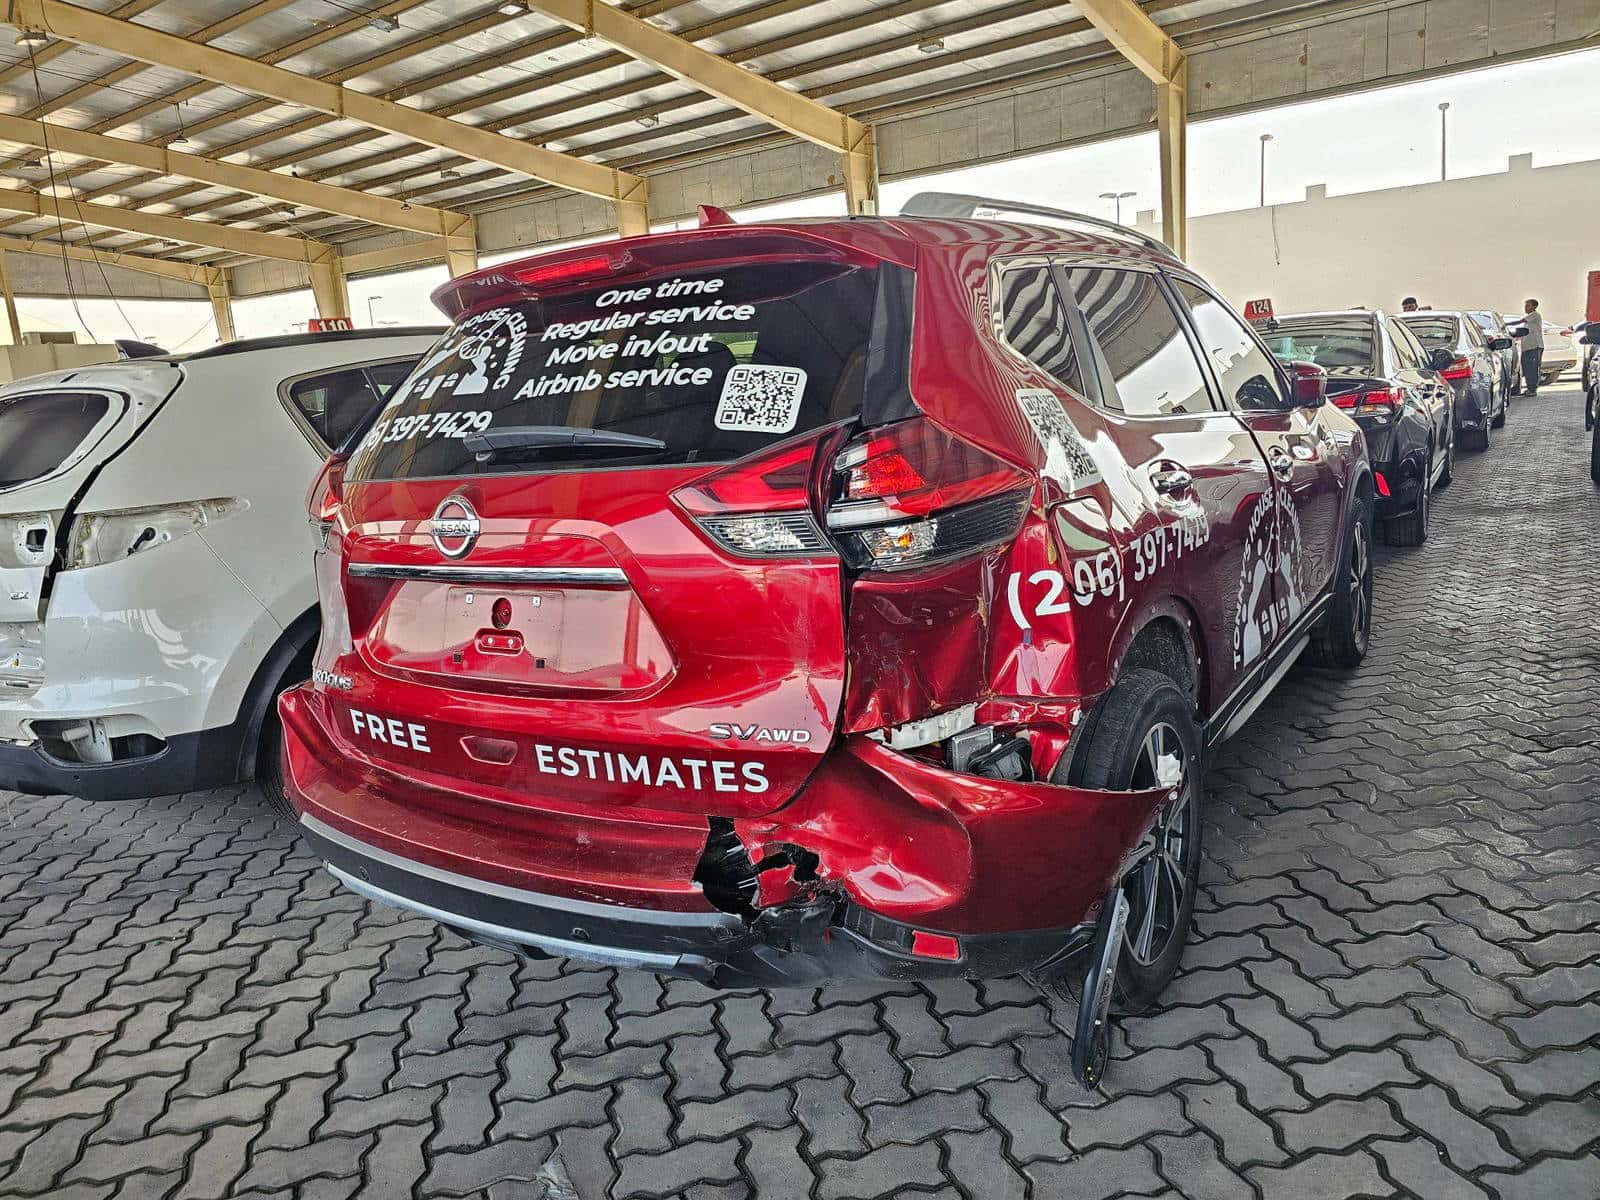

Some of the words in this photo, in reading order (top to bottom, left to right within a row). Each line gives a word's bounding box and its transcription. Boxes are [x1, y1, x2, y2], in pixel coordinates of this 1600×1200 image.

[596, 287, 653, 308] One
[657, 277, 724, 300] time
[1252, 300, 1269, 314] 124
[319, 318, 348, 332] 110
[541, 311, 642, 343] Regular
[645, 299, 755, 326] service
[493, 312, 528, 390] CLEANING
[545, 338, 617, 367] Move
[621, 331, 712, 359] in/out
[513, 371, 602, 401] Airbnb
[606, 364, 712, 388] service
[382, 411, 493, 443] 397-7429
[1248, 486, 1274, 543] HOUSE
[1007, 547, 1125, 630] (206)
[1130, 514, 1210, 582] 397-7429
[349, 708, 432, 753] FREE
[535, 744, 769, 793] ESTIMATES
